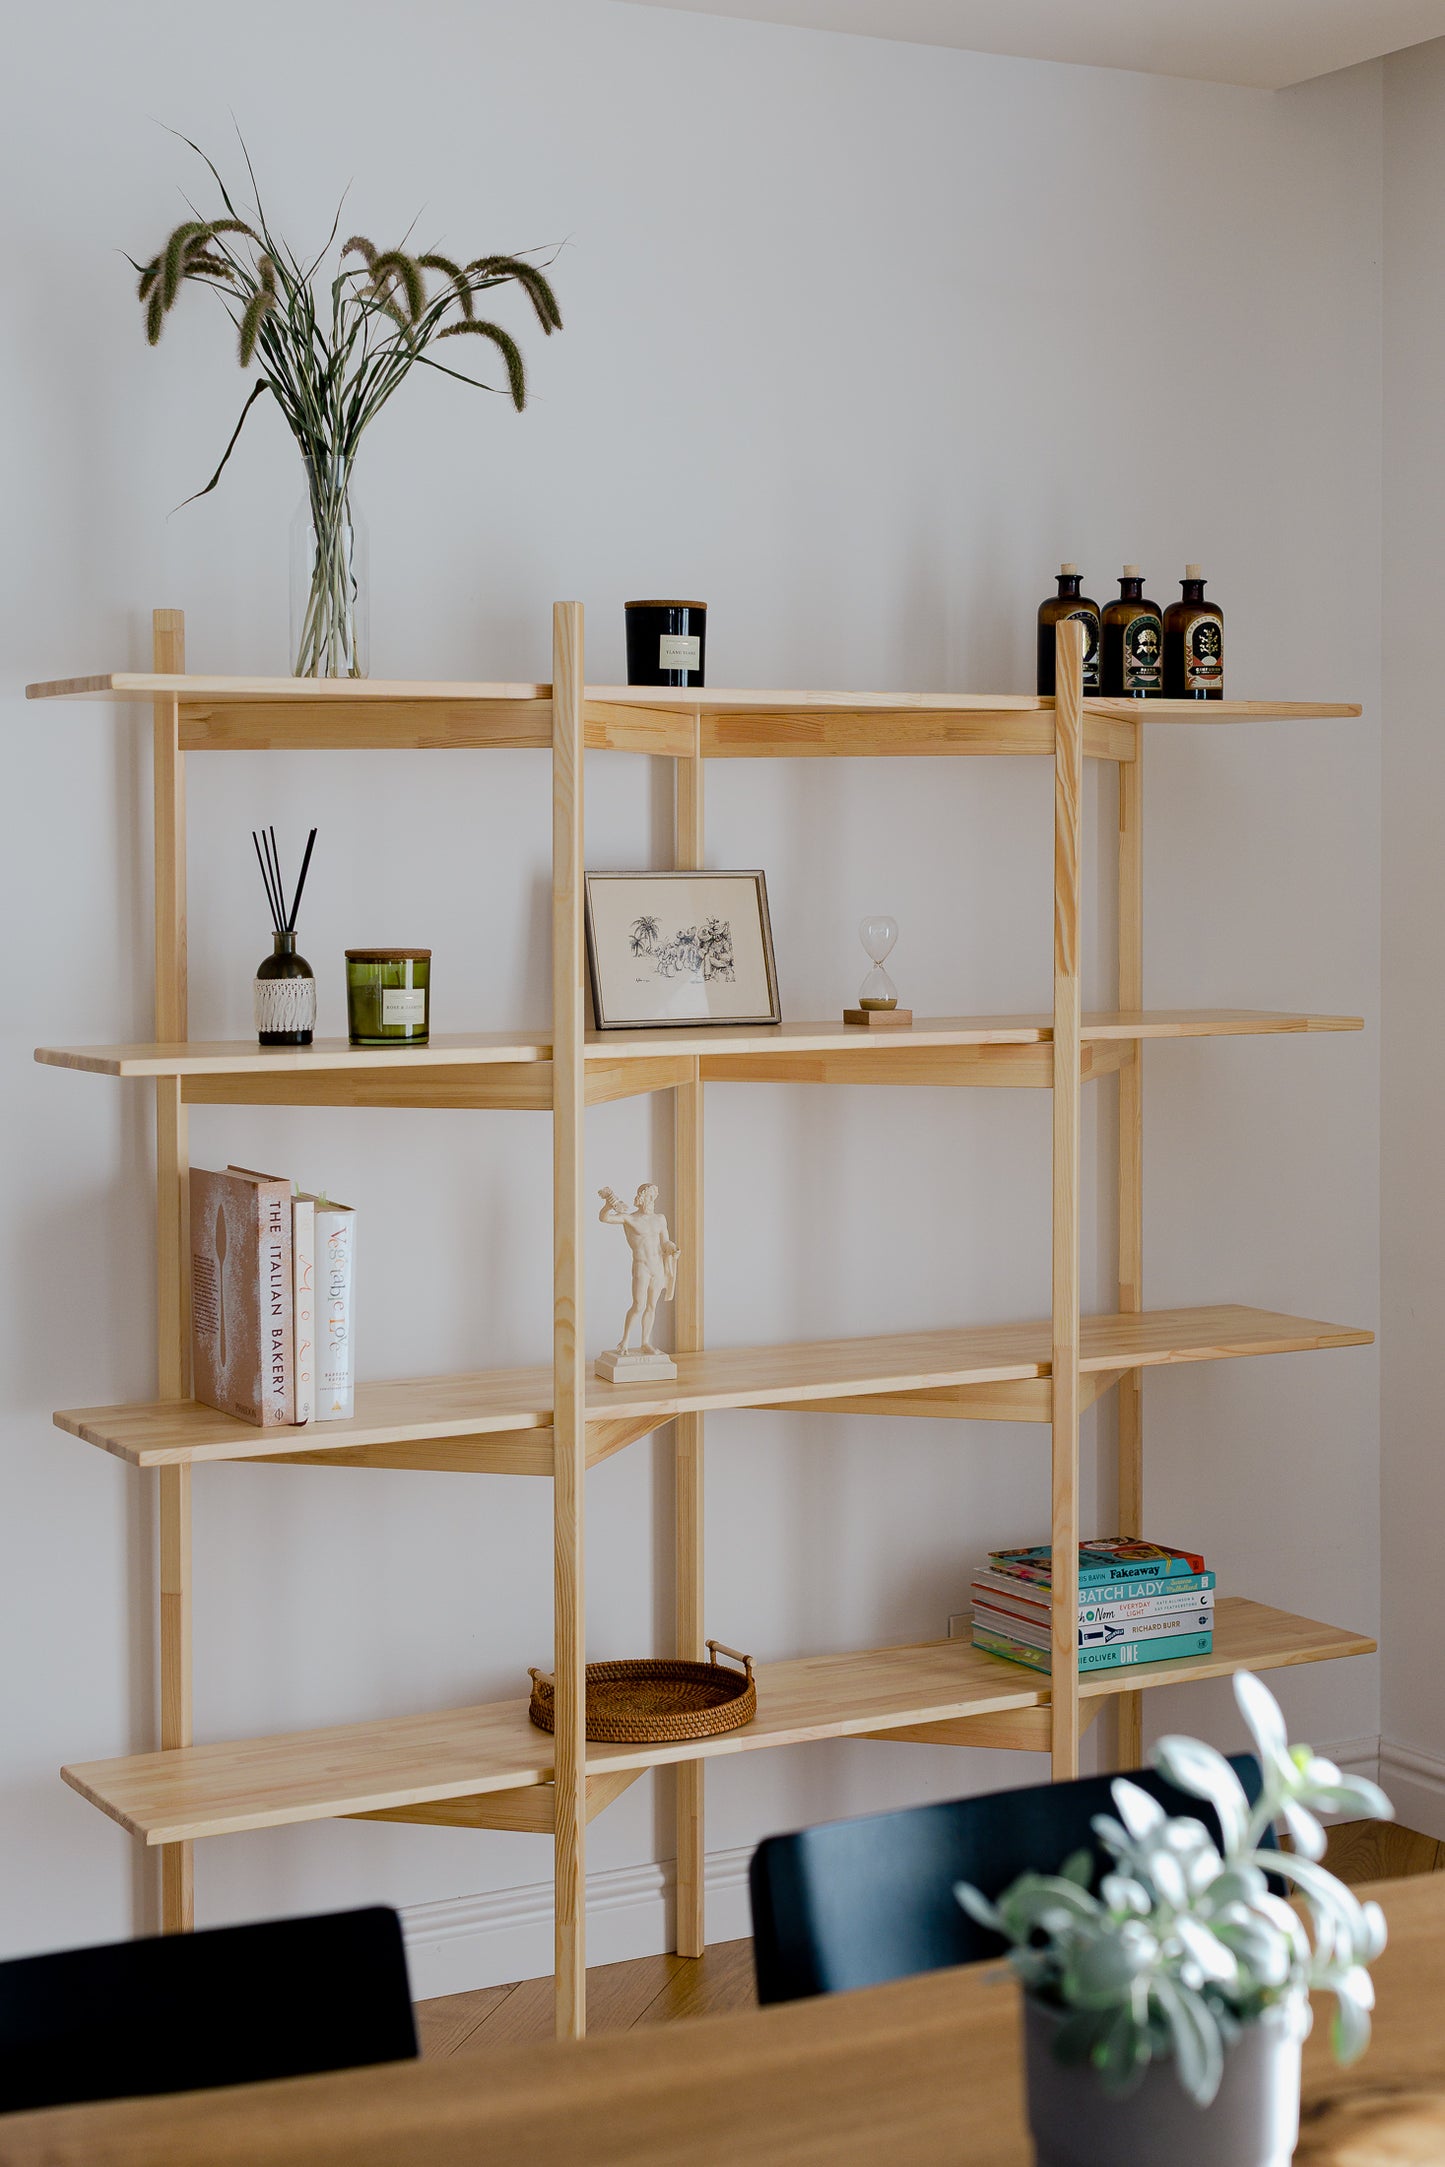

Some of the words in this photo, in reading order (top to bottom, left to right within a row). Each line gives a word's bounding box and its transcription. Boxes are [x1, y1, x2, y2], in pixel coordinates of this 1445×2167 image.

[269, 1200, 282, 1233] THE
[327, 1226, 348, 1312] Vegetable
[269, 1246, 283, 1316] ITALIAN
[328, 1318, 348, 1357] Love
[271, 1328, 285, 1396] BAKERY
[1110, 1566, 1160, 1580] Fakeaway
[1079, 1586, 1124, 1604] BATCH
[1128, 1581, 1165, 1598] LADY
[1095, 1607, 1116, 1622] Nom
[1119, 1600, 1152, 1611] EVERYDAY
[1126, 1608, 1145, 1617] LIGHT
[1132, 1623, 1162, 1634] RICHARD
[1163, 1620, 1181, 1630] BURR
[1088, 1652, 1117, 1663] OLIVER
[1120, 1644, 1139, 1664] ONE
